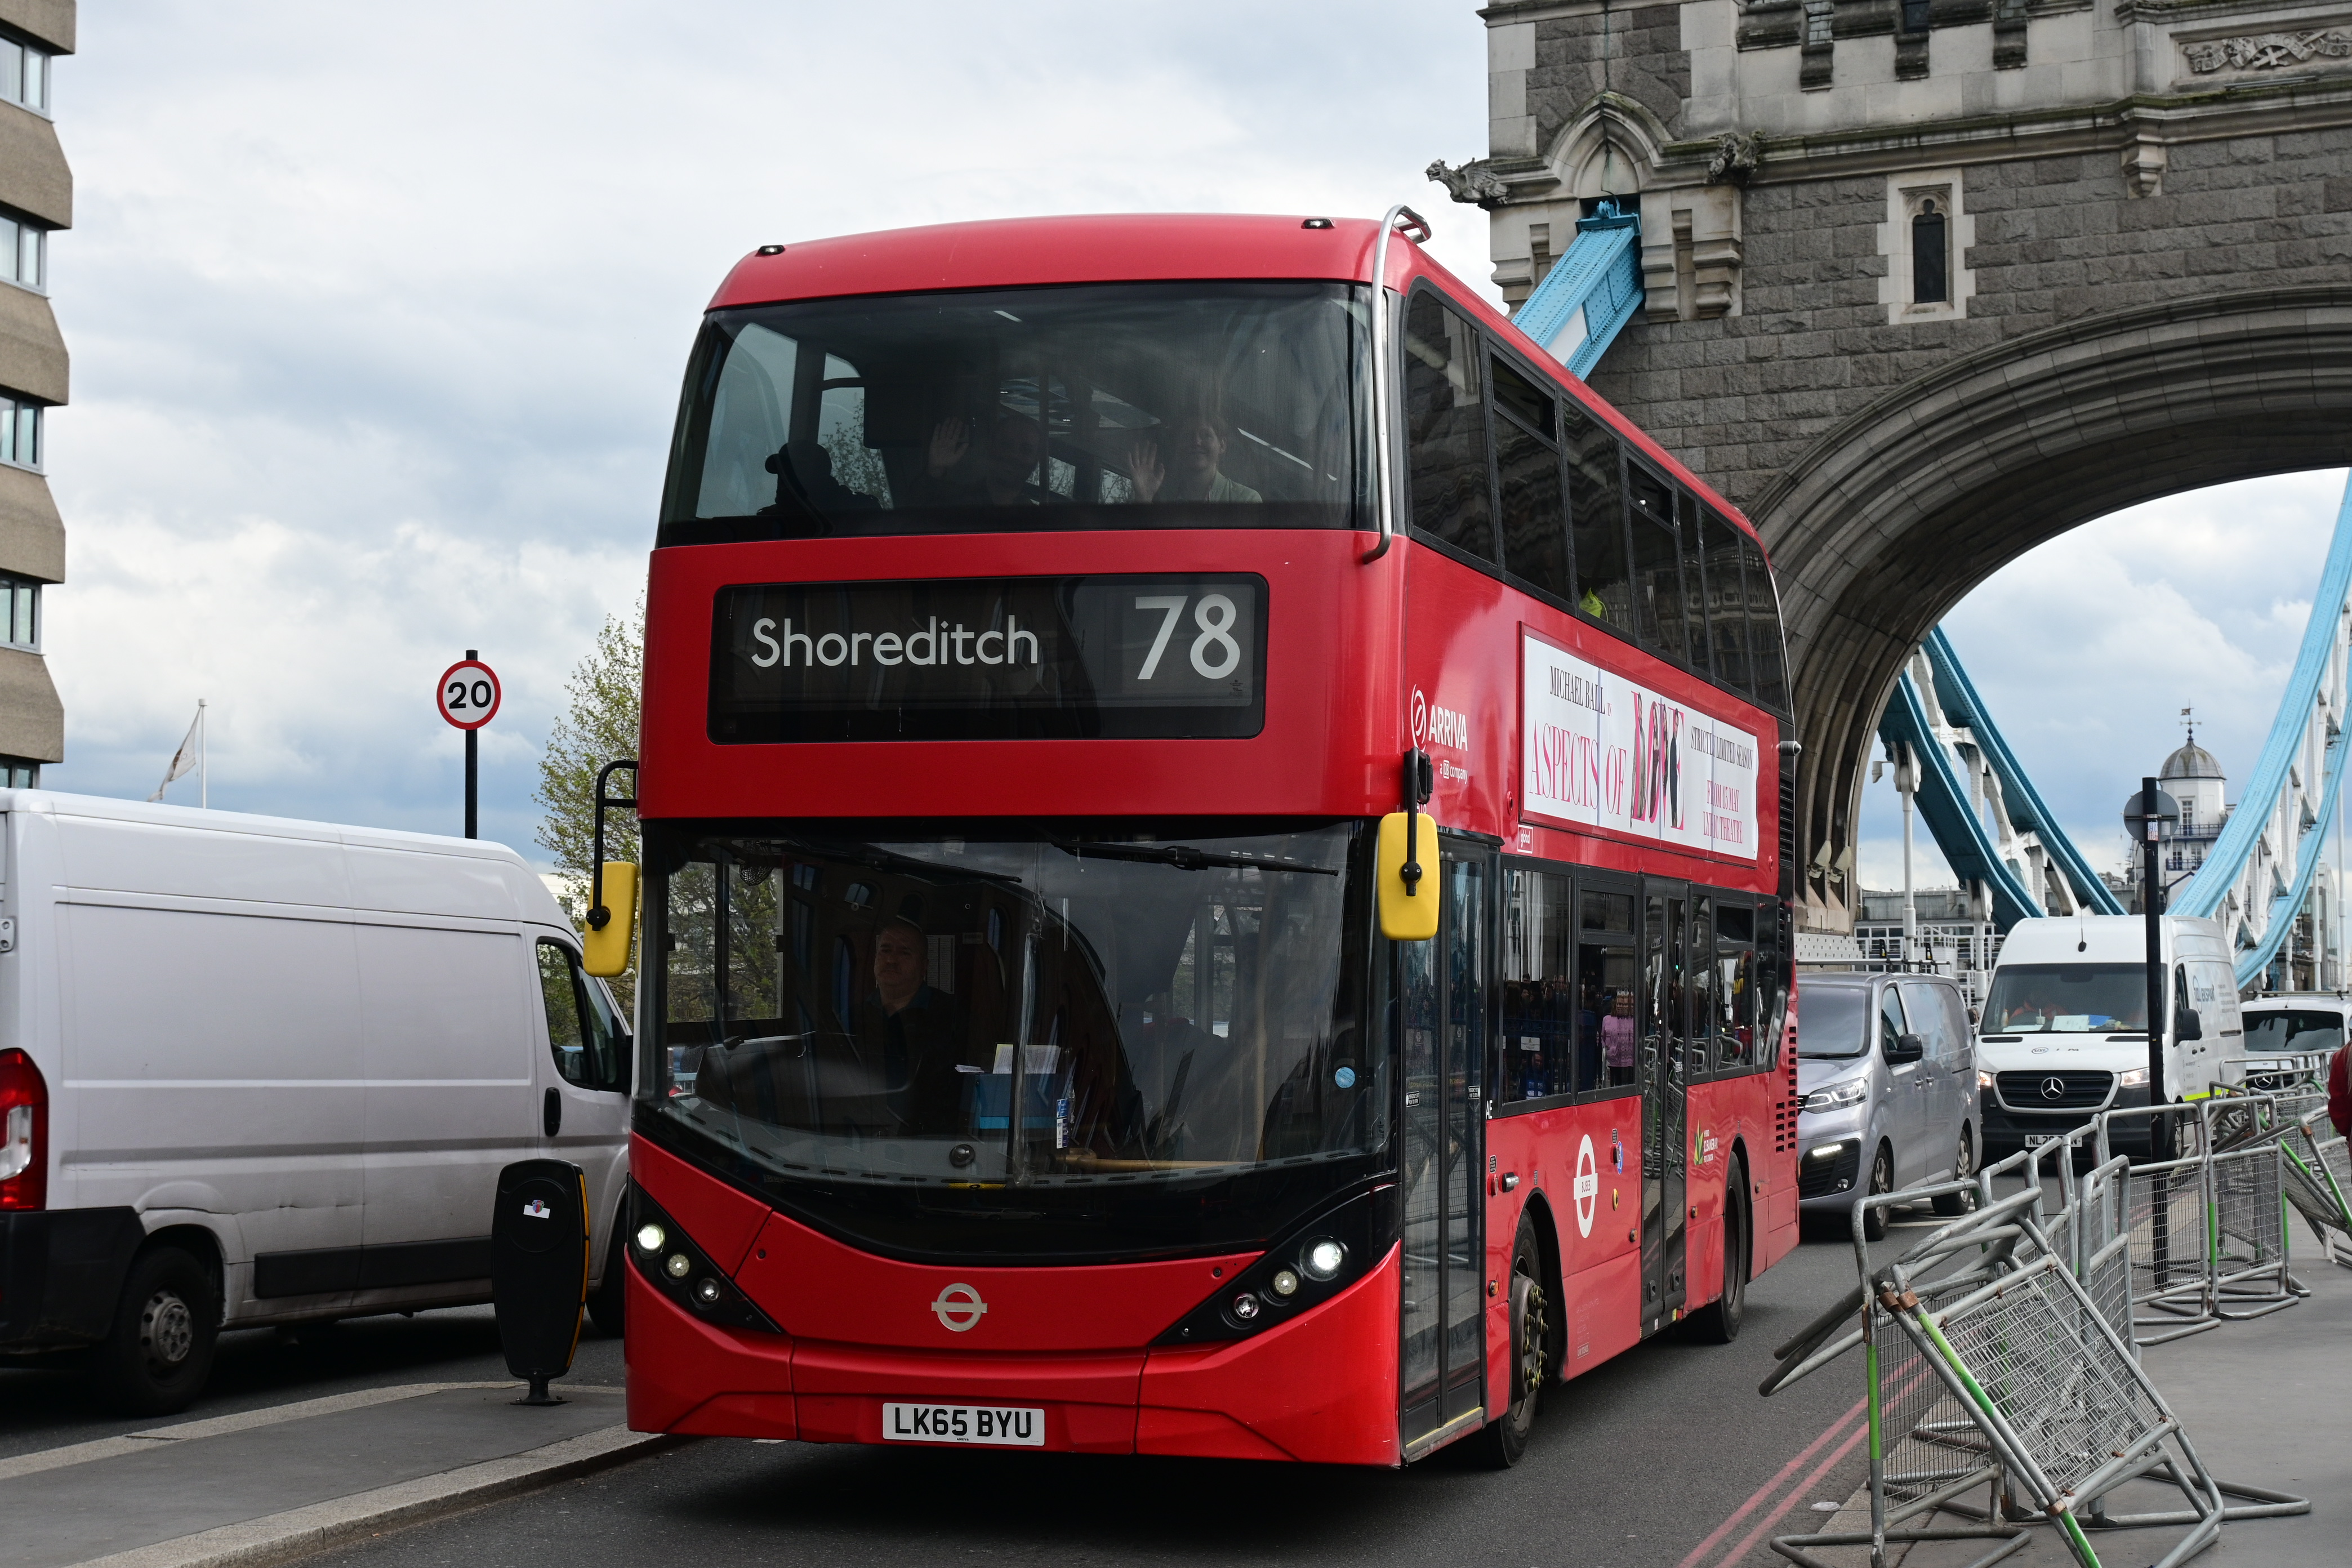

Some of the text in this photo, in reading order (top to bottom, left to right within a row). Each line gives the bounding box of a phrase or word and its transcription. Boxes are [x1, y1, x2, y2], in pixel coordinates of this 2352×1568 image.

[751, 615, 1039, 668] Shoreditch
[1134, 593, 1242, 680] 78
[448, 680, 492, 709] 20
[1549, 665, 1612, 716] MICHAEL BALL IN
[1428, 705, 1468, 752] ARRIVA
[1690, 725, 1753, 770] STRICTLY LIMITED SEASON
[1440, 760, 1468, 785] a DB company
[1529, 719, 1627, 816] ASPECTS OF
[1631, 691, 1685, 831] LOVE
[1707, 779, 1739, 813] FROM 15 MAY
[1703, 811, 1743, 844] LYRIC THEATRE
[1485, 1099, 1493, 1120] AE
[1582, 1179, 1591, 1193] BUSES
[894, 1407, 1032, 1438] LK65 BYU
